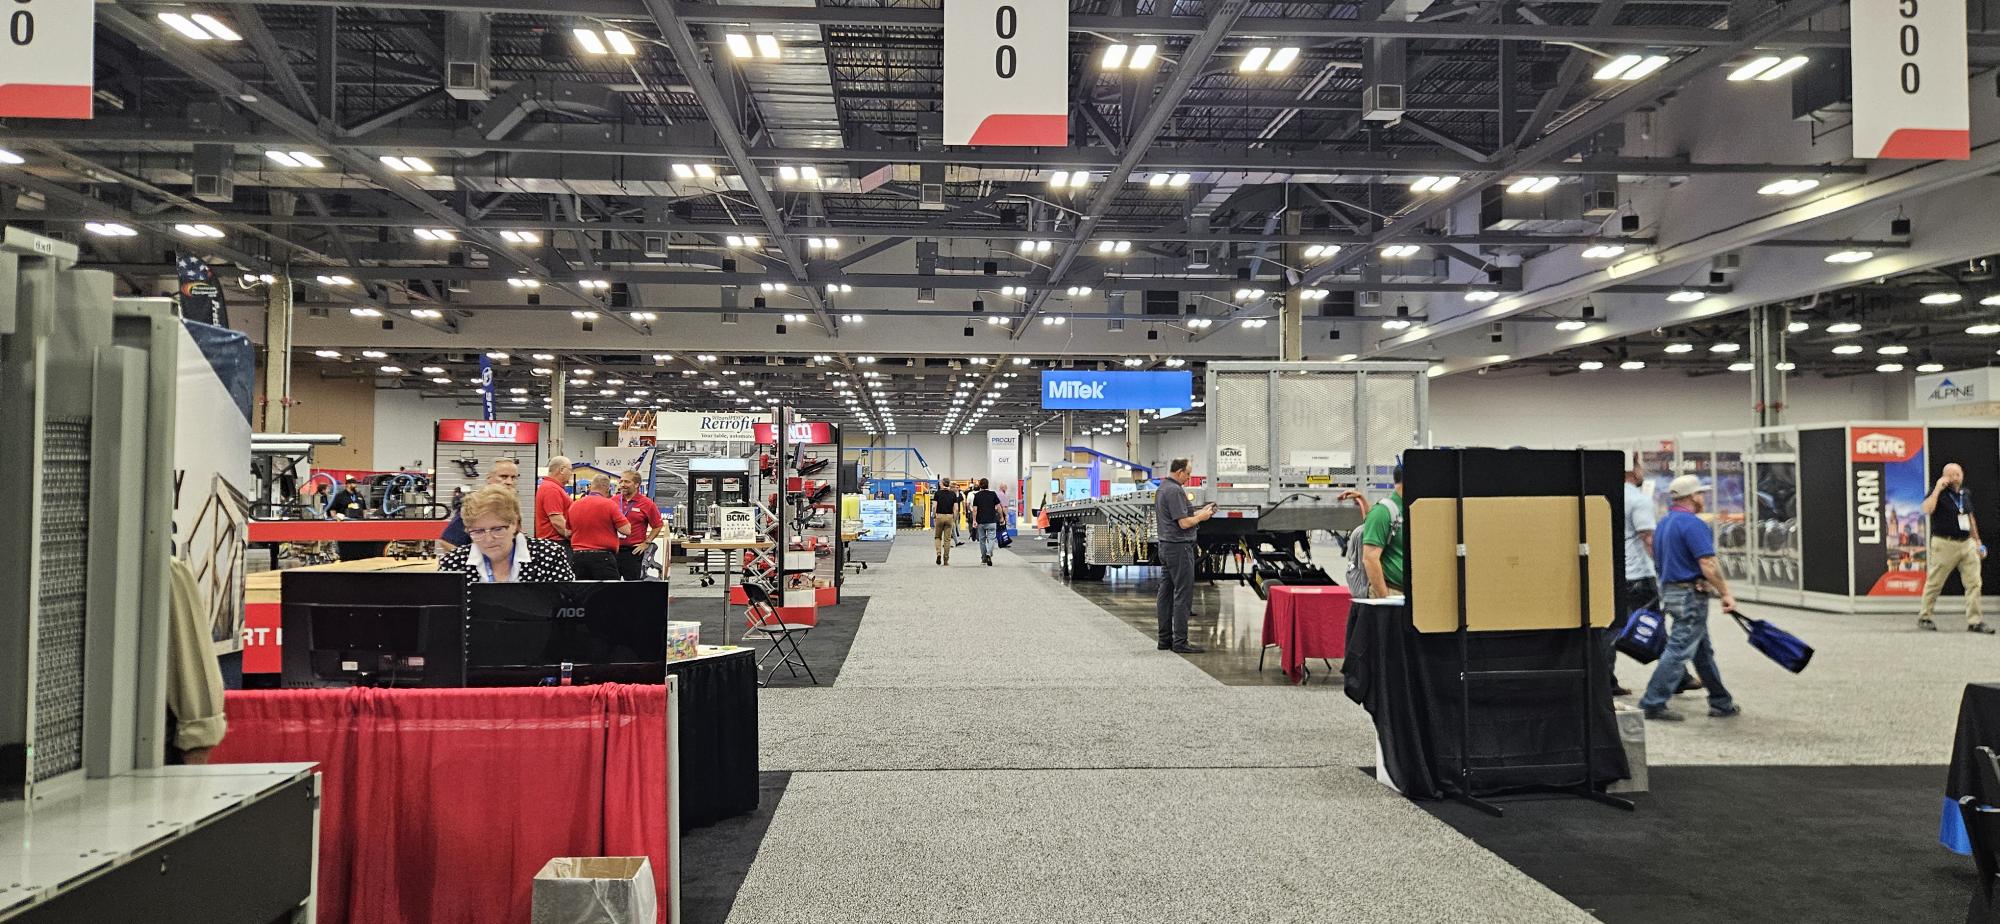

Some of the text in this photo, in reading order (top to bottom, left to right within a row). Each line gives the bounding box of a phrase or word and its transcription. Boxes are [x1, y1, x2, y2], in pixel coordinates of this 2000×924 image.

[1049, 380, 1104, 399] MiTek
[1928, 384, 1974, 400] ALPINE
[463, 421, 517, 438] SENCO
[700, 416, 761, 434] Retrofit!
[771, 424, 811, 438] SNCO
[1856, 439, 1905, 457] BCMC
[1857, 470, 1881, 544] LEARN
[556, 607, 585, 618] AOC
